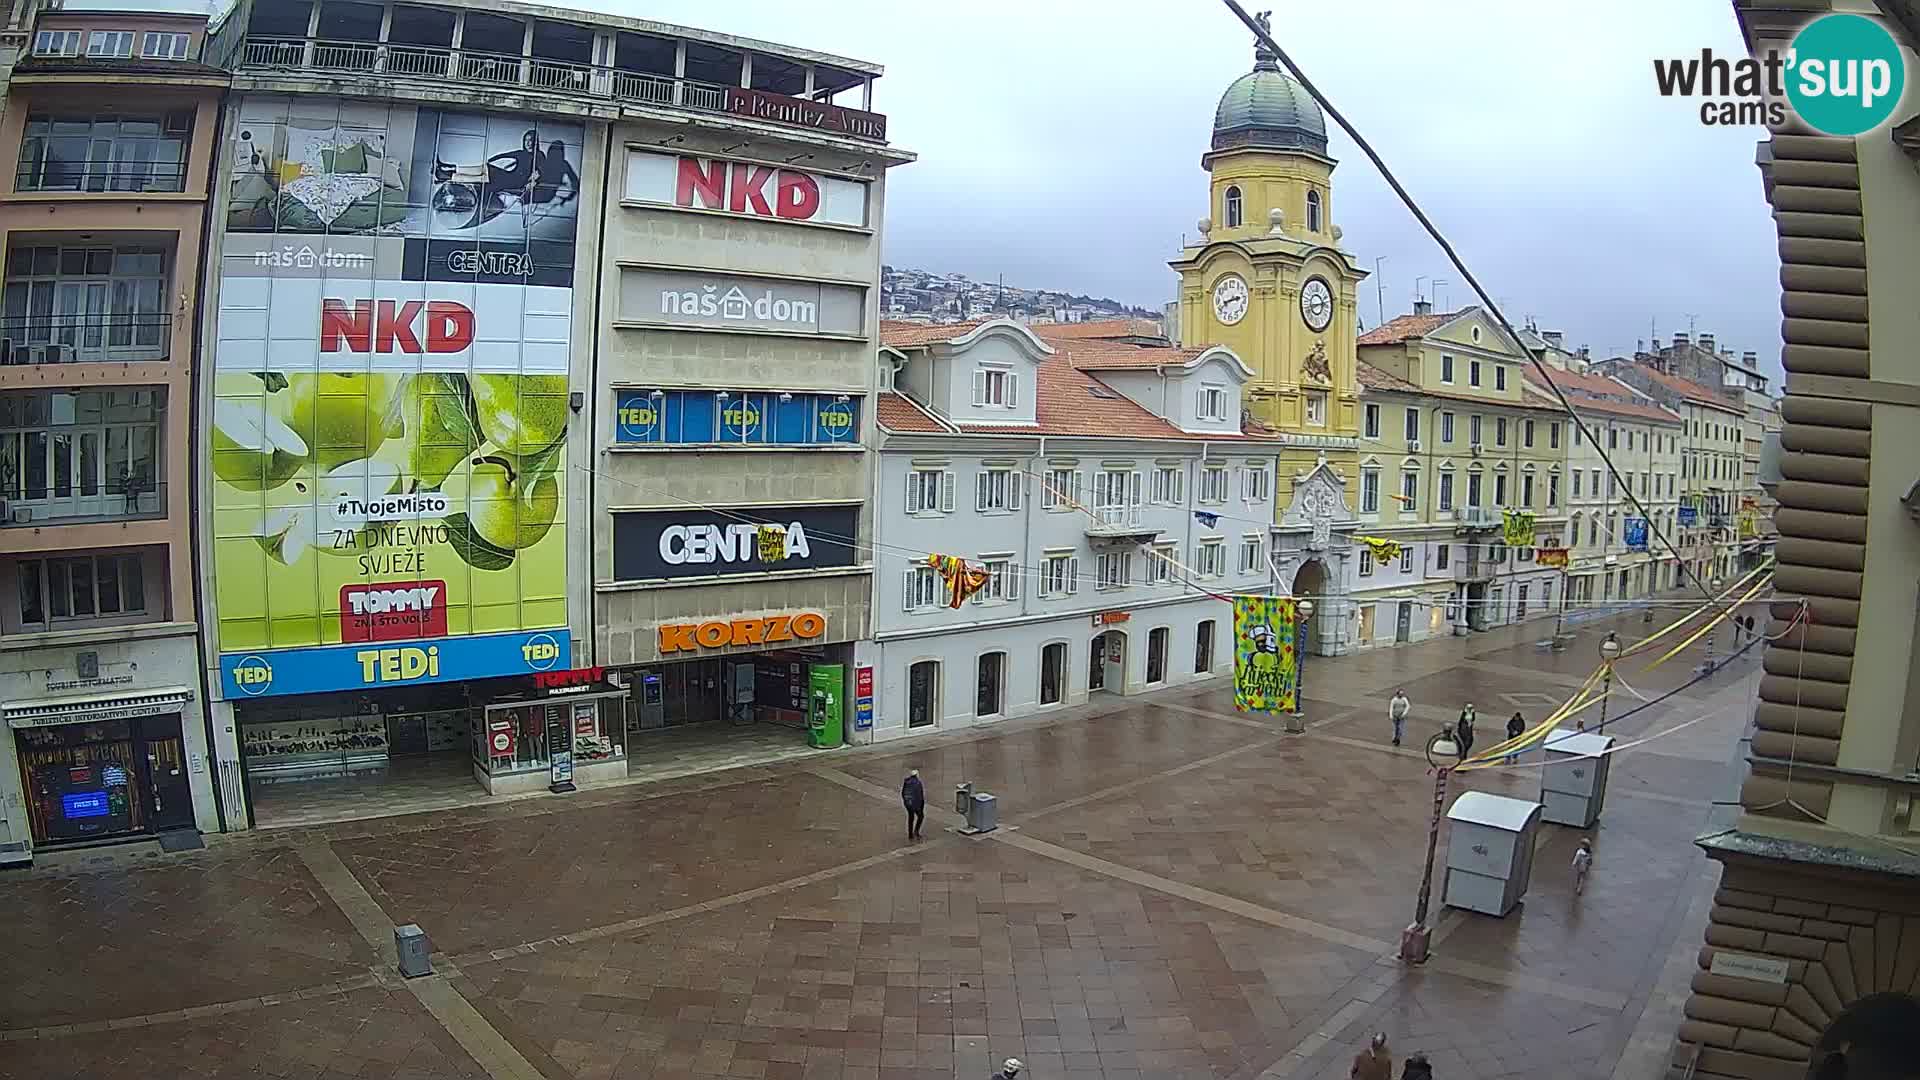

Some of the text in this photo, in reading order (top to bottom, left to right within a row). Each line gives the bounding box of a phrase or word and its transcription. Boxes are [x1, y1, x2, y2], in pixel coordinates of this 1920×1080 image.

[723, 89, 745, 113] Le
[675, 158, 821, 222] NKD
[254, 246, 366, 269] naš dom
[447, 249, 534, 277] CENTRA
[660, 283, 817, 323] naš dom
[320, 297, 477, 355] NKD
[618, 408, 657, 425] TEDi
[723, 409, 760, 426] TEDi
[820, 411, 852, 427] TEDi
[337, 498, 446, 517] #TvojeMisto
[333, 525, 450, 549] ZA DNEVNO
[659, 521, 811, 565] CENTA
[359, 548, 426, 575] SVJEŽE
[348, 586, 439, 615] TOMMY
[658, 613, 826, 654] KORZO
[357, 645, 440, 683] TEDi
[521, 643, 561, 661] TEDi
[233, 665, 273, 685] TEDi
